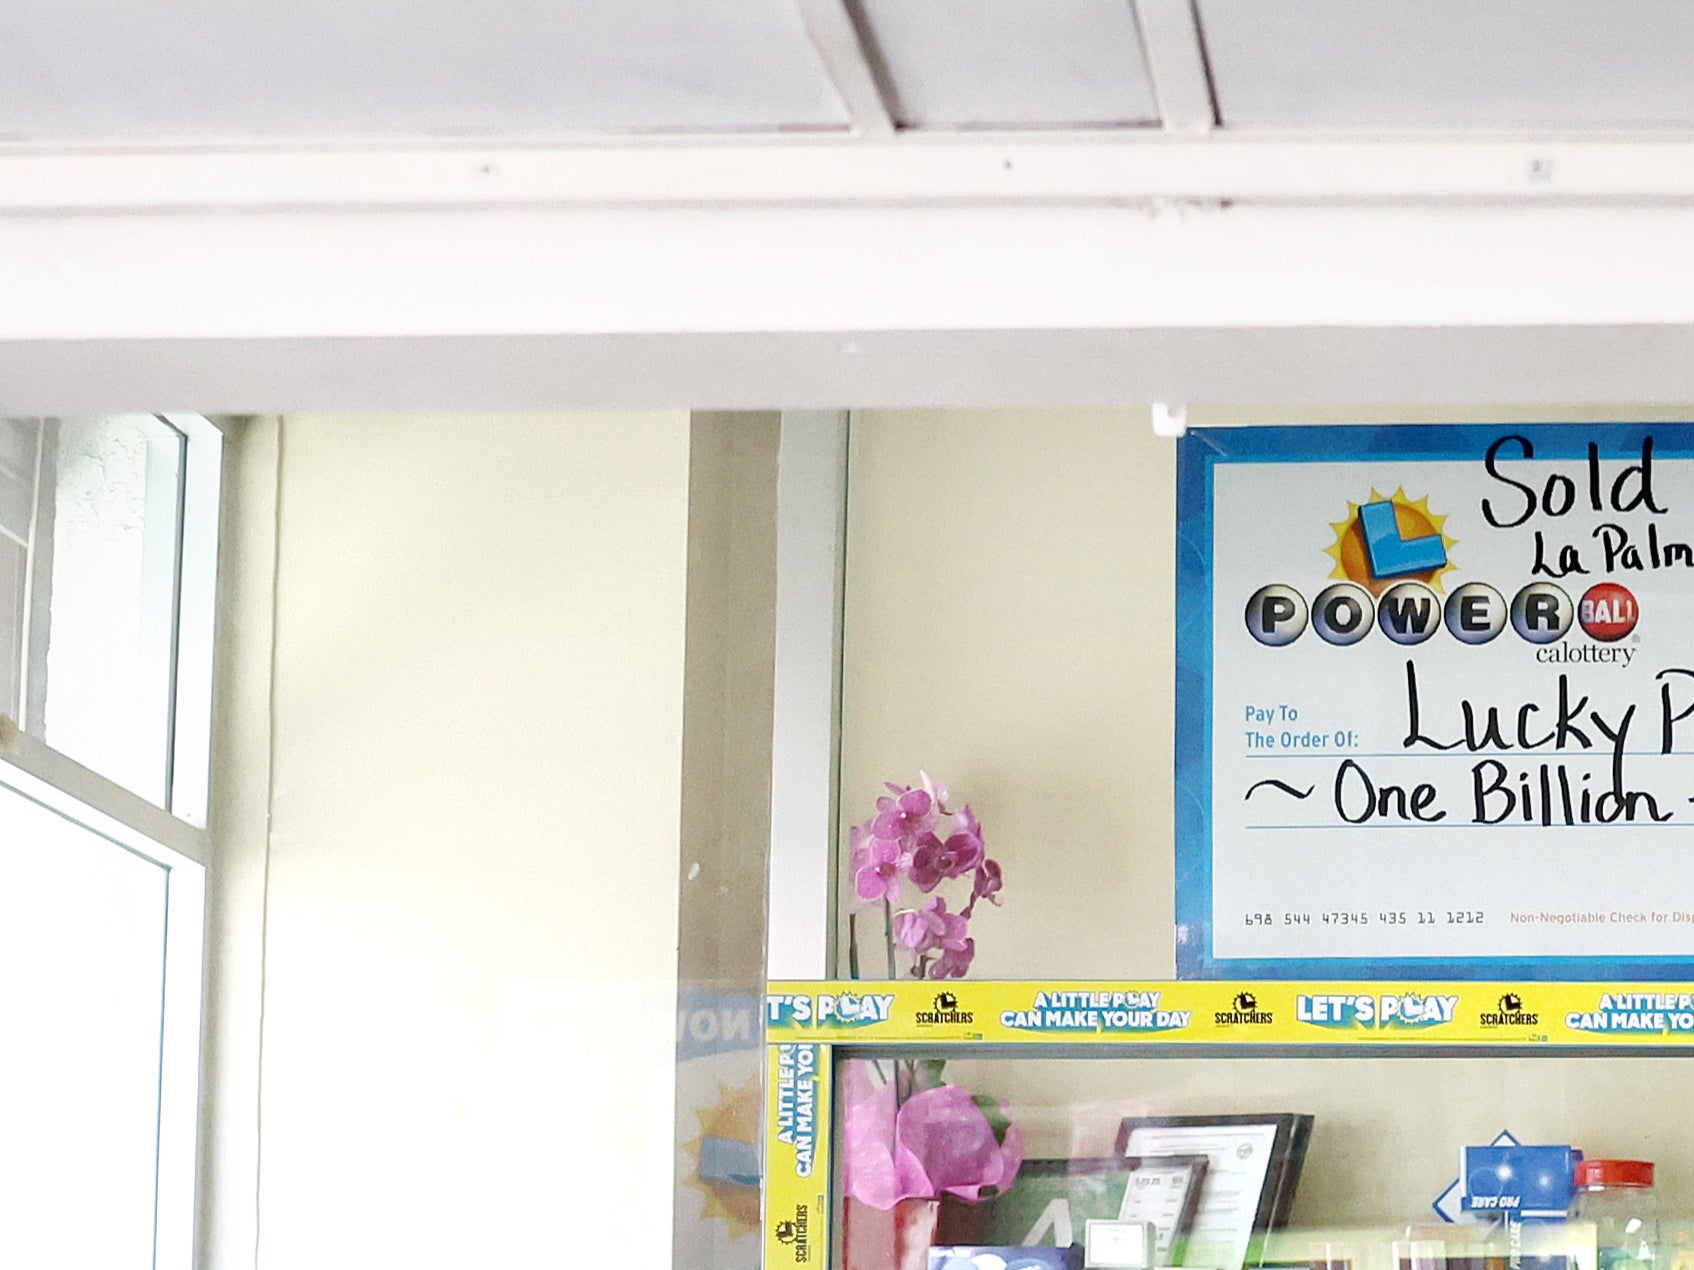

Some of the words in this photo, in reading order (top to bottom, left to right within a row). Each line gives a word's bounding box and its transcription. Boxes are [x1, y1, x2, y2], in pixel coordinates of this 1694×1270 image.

[1481, 435, 1667, 528] Sold
[1531, 530, 1588, 578] La
[1536, 641, 1638, 667] calottery
[1245, 706, 1275, 725] Pay
[1278, 706, 1299, 722] To
[1403, 660, 1636, 788] Lucky
[1245, 730, 1275, 748] The
[1279, 730, 1326, 748] Order
[1330, 730, 1359, 748] Of:
[1333, 759, 1447, 823] One
[1471, 759, 1674, 826] Billion
[1245, 910, 1273, 926] 698
[1284, 910, 1311, 926] 544
[1321, 910, 1369, 926] 47345
[1379, 910, 1408, 925] 435
[1417, 910, 1436, 925] 11
[1446, 910, 1485, 924] 1212
[1509, 910, 1605, 924] Non-Negotiable
[1609, 910, 1647, 924] Check
[1650, 910, 1668, 924] for
[1034, 992, 1051, 1008] A
[1050, 992, 1109, 1008] LITTLE
[1296, 995, 1375, 1022] LET'S
[916, 1011, 973, 1024] SCRATCHERS
[1000, 1010, 1037, 1028] CAN
[1038, 1010, 1098, 1028] MAKE
[1101, 1010, 1153, 1028] YOUR
[1154, 1010, 1191, 1028] DAY
[1471, 1196, 1499, 1208] CARE
[1500, 1196, 1520, 1208] PRO
[795, 1203, 806, 1263] SCRATCHERS
